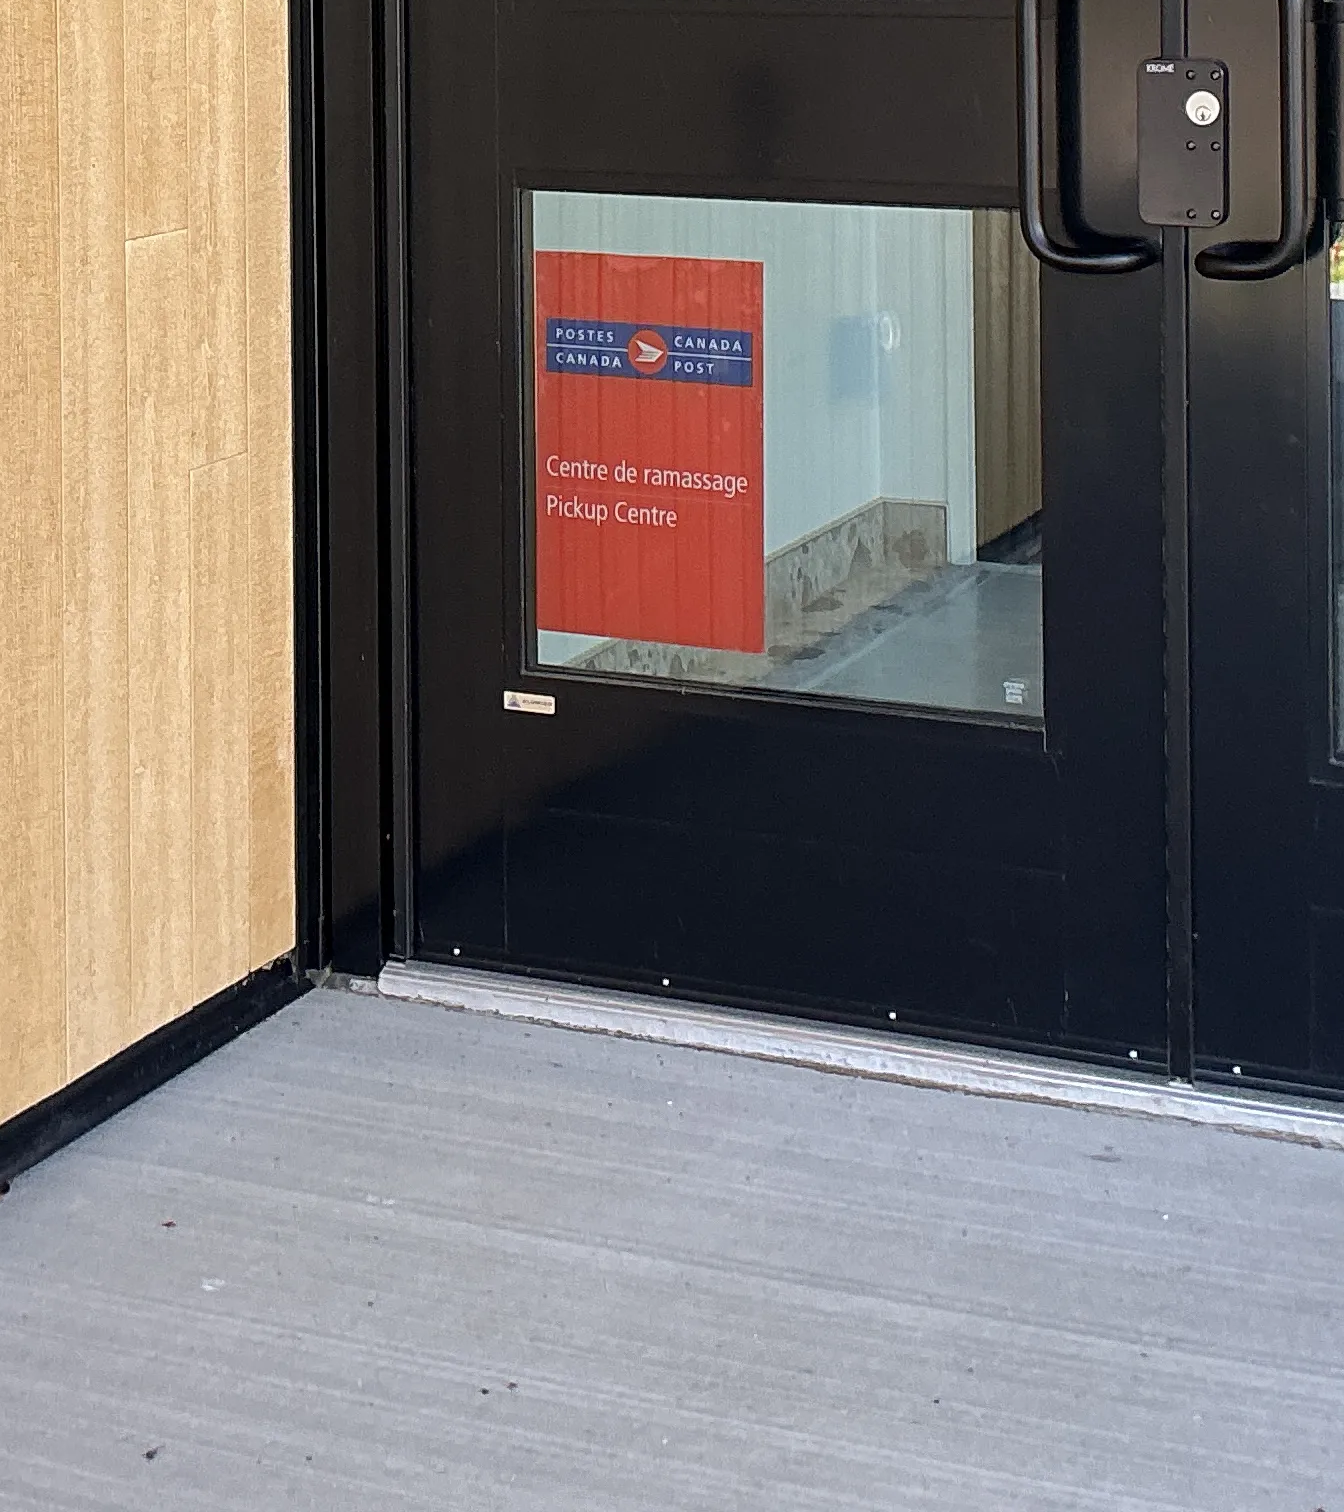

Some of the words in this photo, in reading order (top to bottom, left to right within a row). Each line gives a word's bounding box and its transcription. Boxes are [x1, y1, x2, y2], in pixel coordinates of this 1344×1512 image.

[555, 327, 615, 343] POSTES
[673, 334, 743, 353] CANADA
[555, 351, 622, 369] CANADA
[673, 360, 714, 376] POST
[546, 454, 608, 483] Centre
[613, 458, 637, 485] de
[643, 467, 749, 499] ramassage
[546, 494, 608, 524] Pickup
[613, 500, 678, 528] Centre
